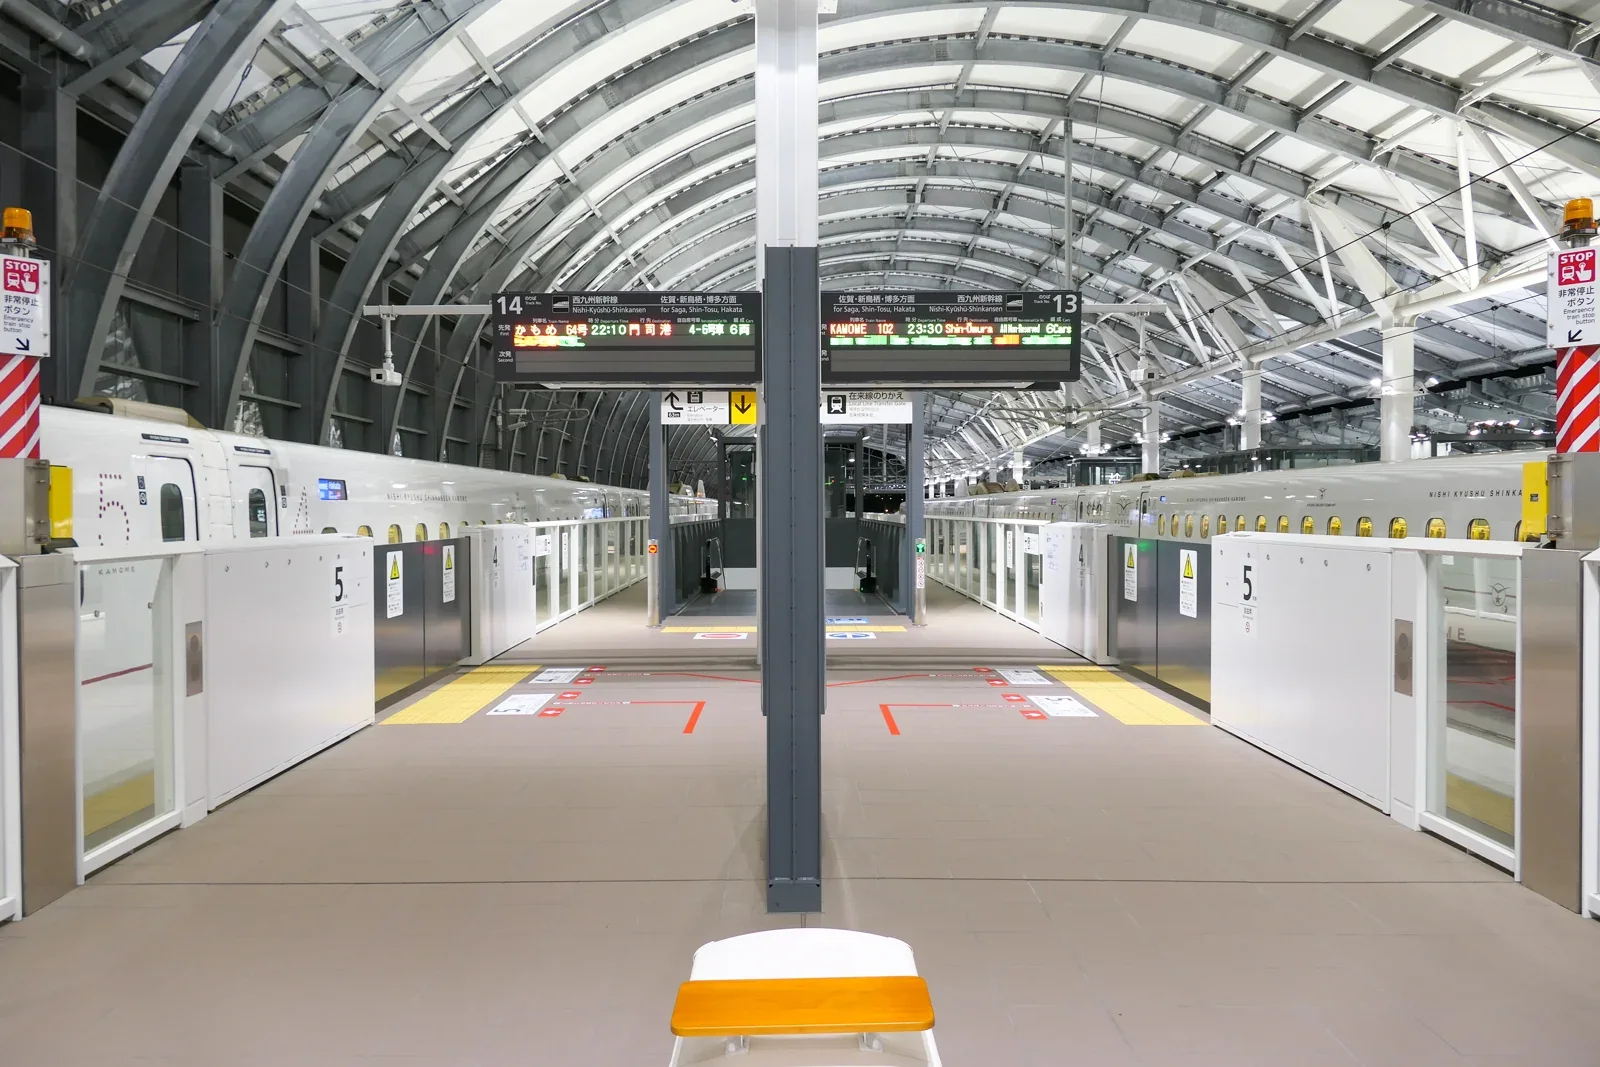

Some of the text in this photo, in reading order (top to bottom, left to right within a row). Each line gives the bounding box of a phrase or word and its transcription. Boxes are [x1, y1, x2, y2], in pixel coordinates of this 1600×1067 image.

[1561, 252, 1593, 264] STOP
[6, 261, 37, 272] STOP
[1558, 286, 1595, 298] 非常停止
[4, 295, 39, 306] 非常停止
[572, 295, 618, 304] 西九州新幹線
[957, 294, 1003, 303] 西九州新幹線
[1567, 298, 1595, 307] ボタン
[497, 296, 523, 315] 14
[1052, 294, 1077, 314] 13
[4, 305, 30, 315] ボタン
[572, 306, 646, 315] Nishi-Kyūshū-Shinkansen
[672, 306, 688, 315] Saga,
[689, 306, 720, 314] Shin-Tosu,
[844, 306, 860, 314] Saga,
[861, 305, 892, 314] Shin-Tosu,
[894, 305, 915, 313] Hakata
[929, 305, 1003, 314] Nishi-Kyūshū-Shinkansen
[4, 315, 34, 323] Emergency
[591, 324, 627, 336] 22:10
[830, 323, 867, 334] KAMOME
[878, 323, 894, 334] 102
[907, 323, 943, 334] 23:30
[848, 391, 904, 400] 在来線のりかえ
[1490, 489, 1523, 497] SHINKA
[98, 566, 136, 575] KAMOME
[335, 566, 343, 602] 5
[1243, 565, 1252, 601] 5
